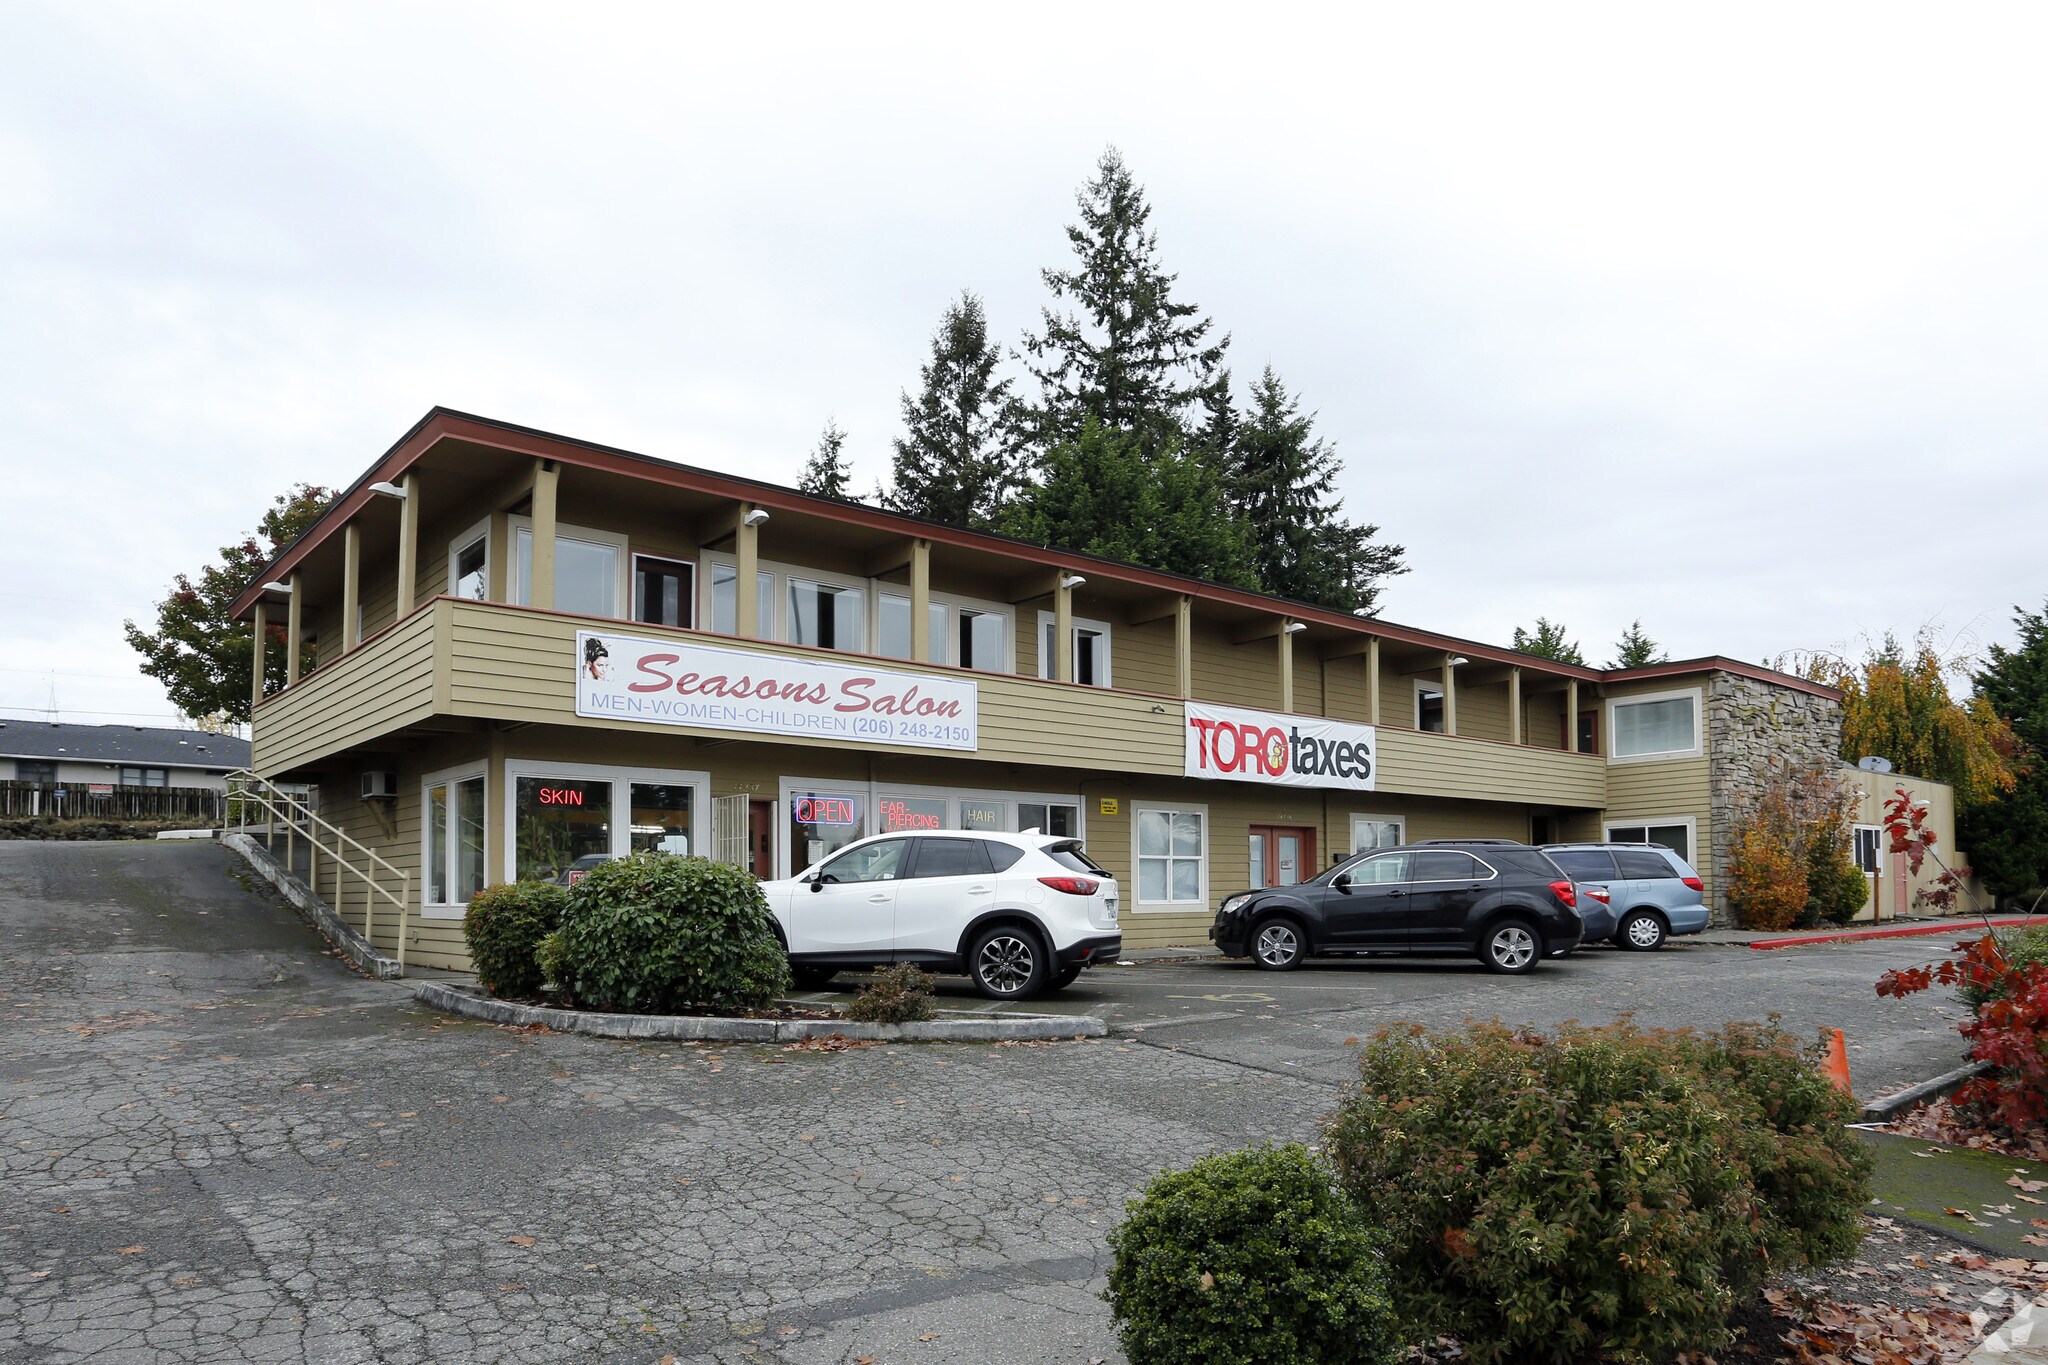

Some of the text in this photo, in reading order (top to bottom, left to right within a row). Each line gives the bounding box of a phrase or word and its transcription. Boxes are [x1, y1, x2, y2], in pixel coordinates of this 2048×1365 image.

[627, 653, 962, 718] Seasons Salon
[591, 692, 970, 742] MEN-WOMEN-CHILDREN (206) 248-2150
[1190, 717, 1371, 780] TORO taxes
[539, 787, 583, 806] SKIN
[798, 799, 852, 823] OPEN
[887, 813, 940, 828] PIERCING
[967, 809, 996, 823] HAIR
